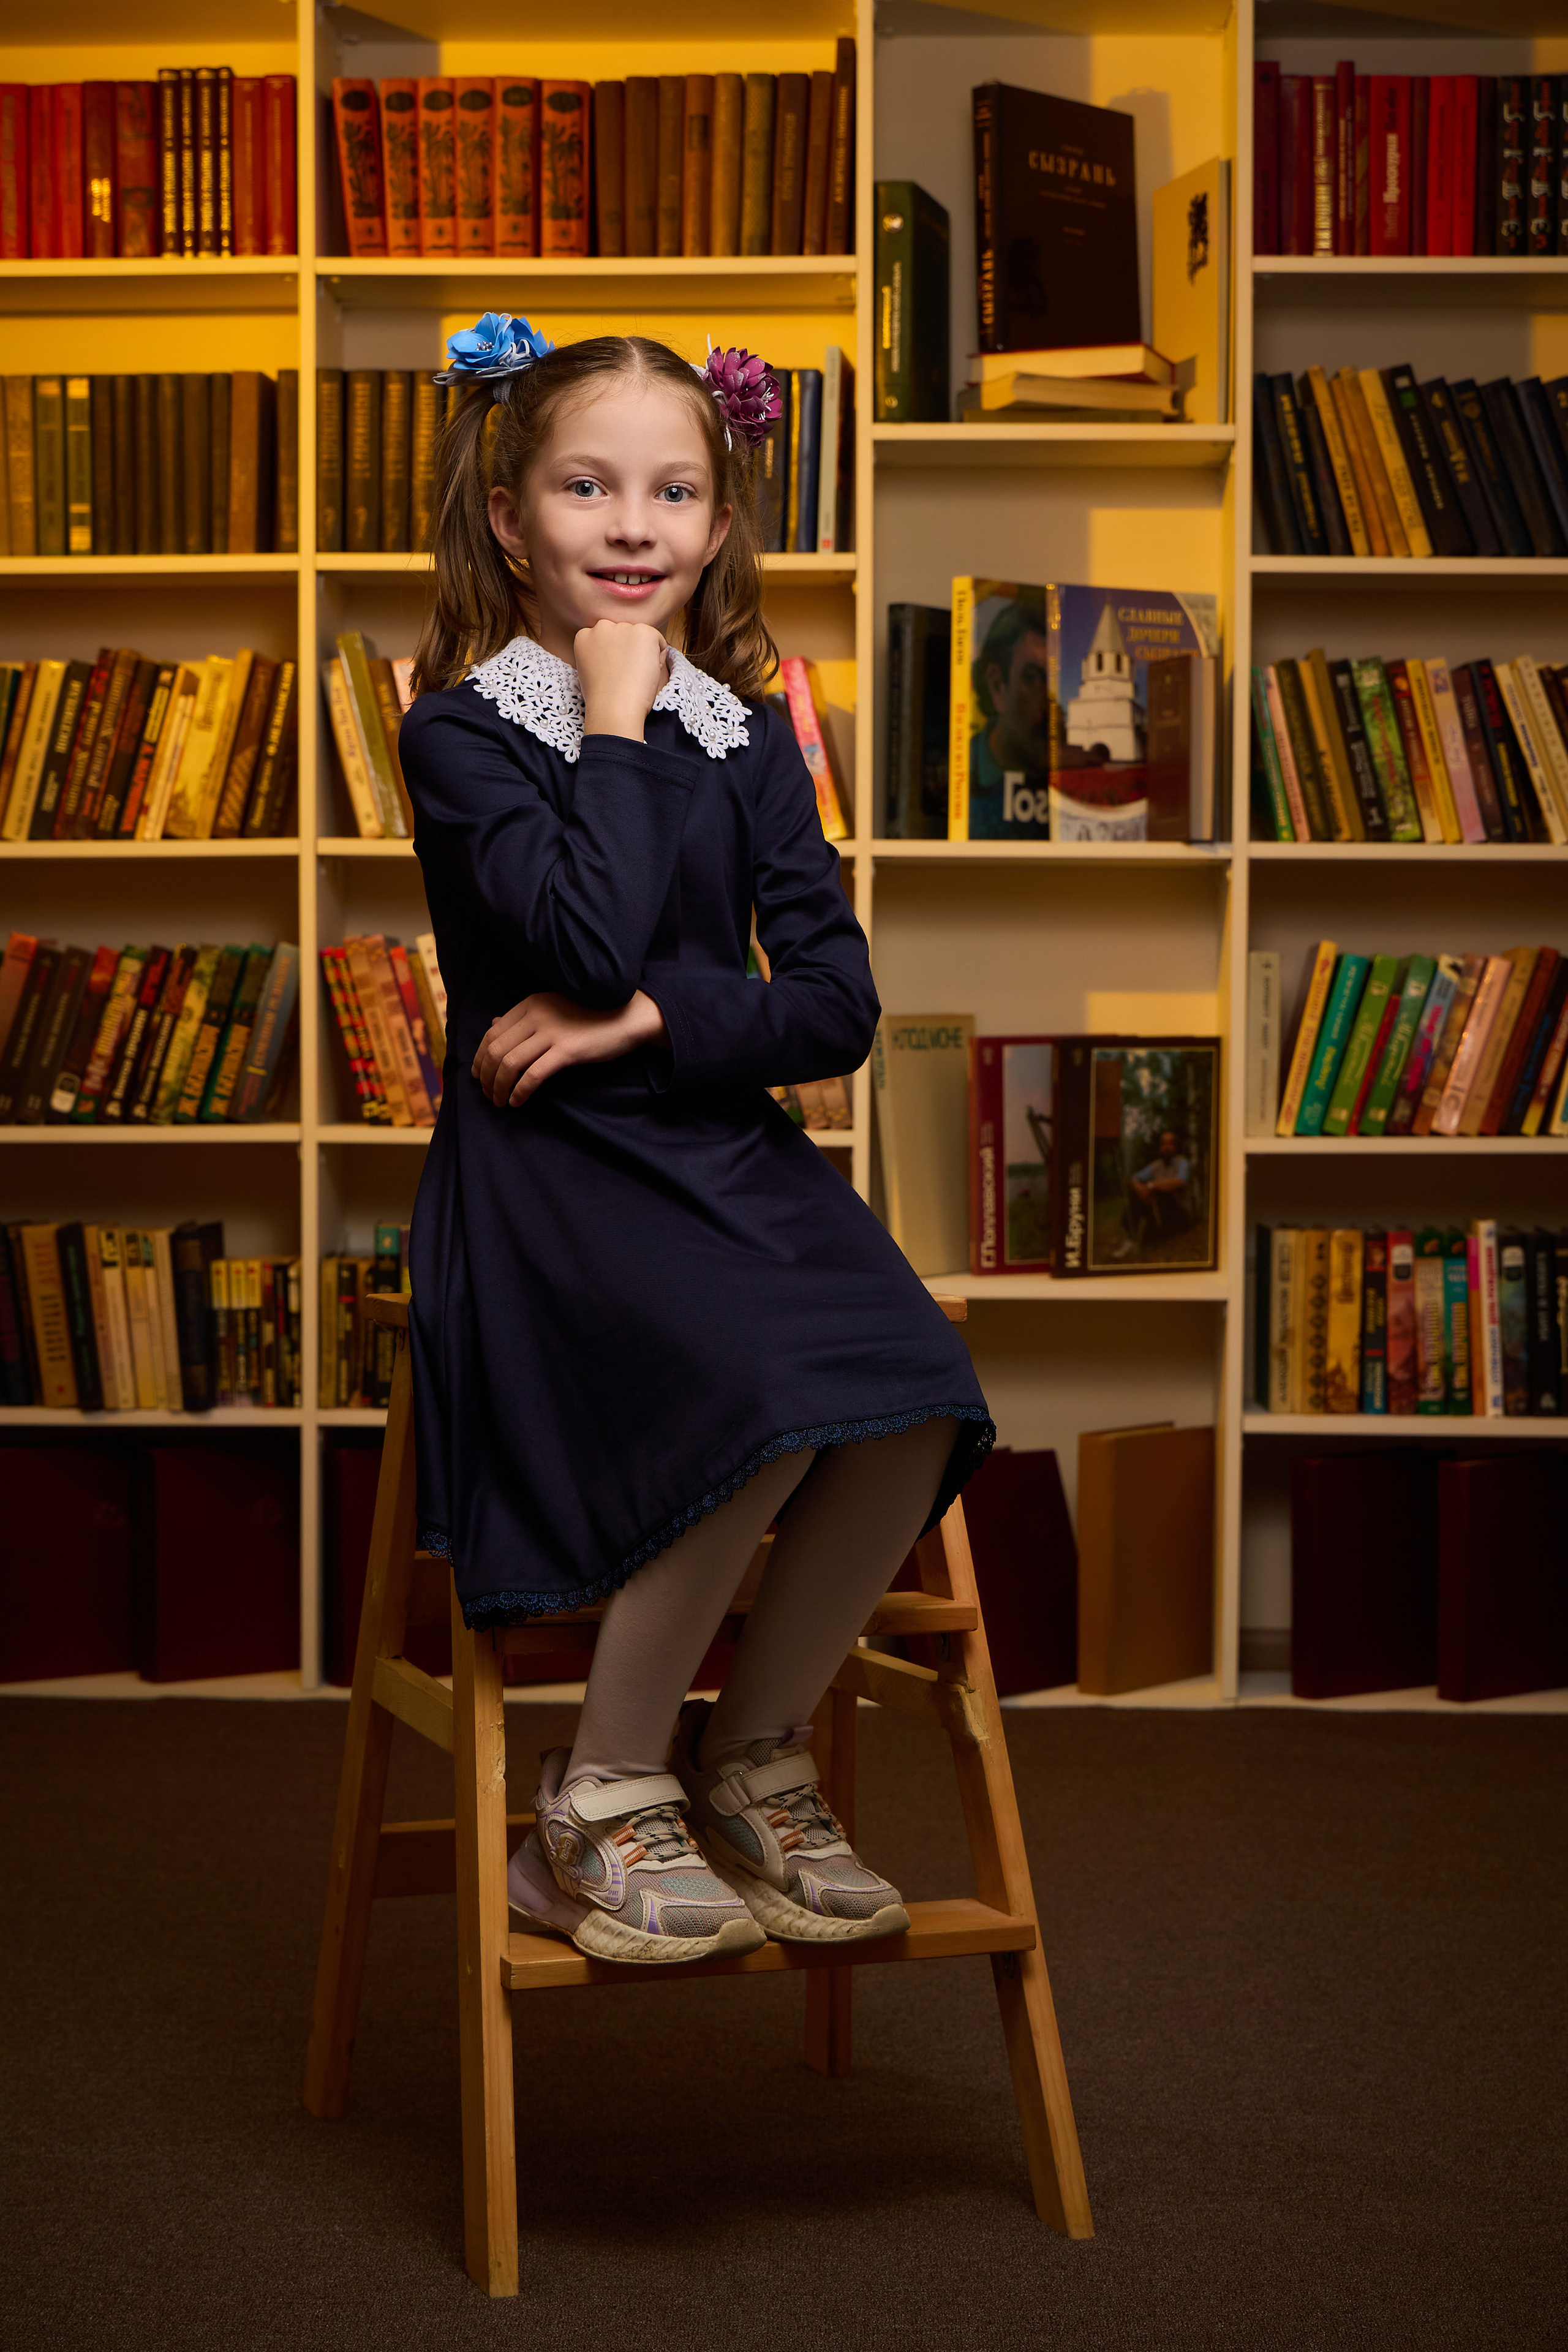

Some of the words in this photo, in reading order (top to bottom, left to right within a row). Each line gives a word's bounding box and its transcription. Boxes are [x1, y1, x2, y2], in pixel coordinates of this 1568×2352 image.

[1028, 149, 1117, 187] СЫЗРАНЬ
[981, 249, 995, 325] СЫЗРАНЬ
[1118, 606, 1185, 626] СЛАВНЫЕ
[1065, 1185, 1084, 1268] И.Бруни
